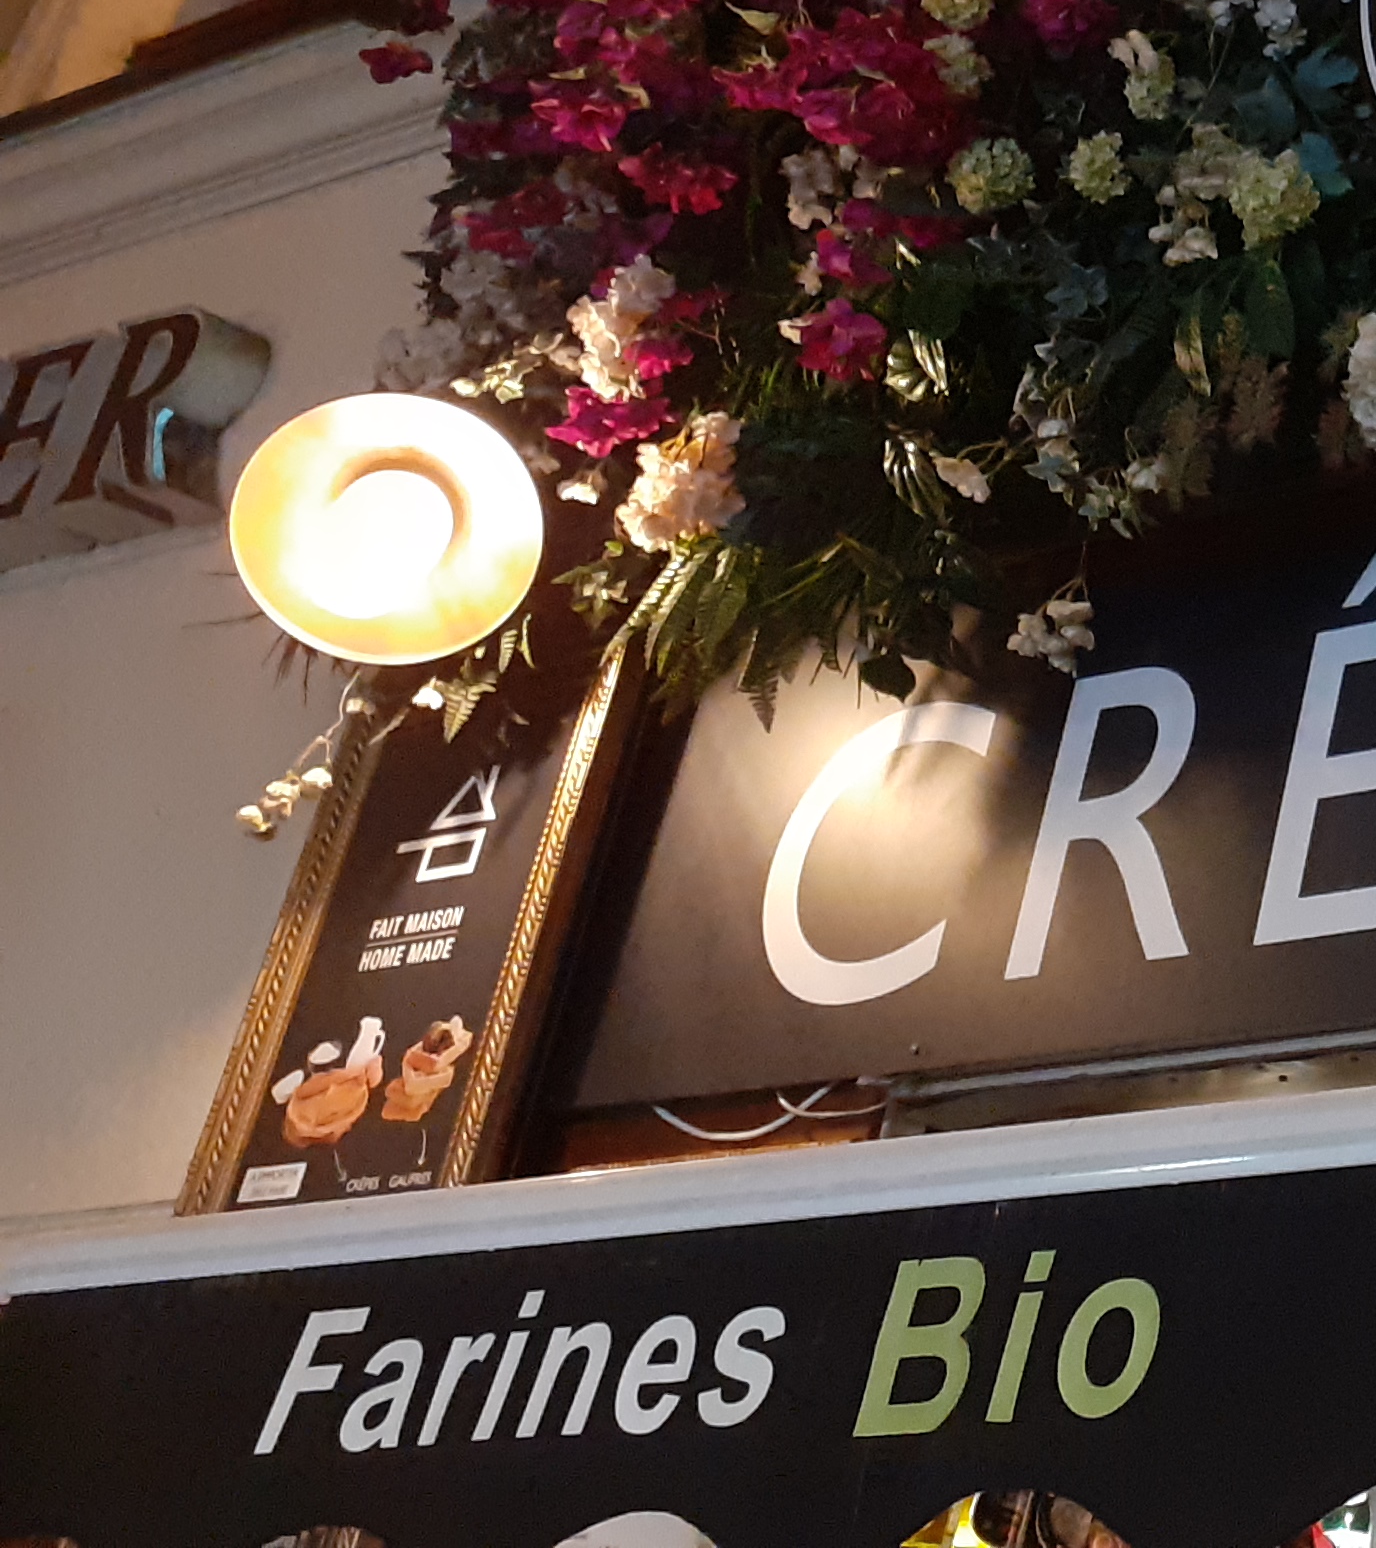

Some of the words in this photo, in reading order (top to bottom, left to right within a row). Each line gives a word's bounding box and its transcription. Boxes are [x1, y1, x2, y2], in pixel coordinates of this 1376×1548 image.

[369, 915, 405, 940] FAIT
[404, 905, 465, 935] MAISON
[358, 944, 407, 972] HOME
[406, 936, 456, 964] MADE
[254, 1289, 785, 1456] Farines
[852, 1249, 1162, 1439] Bio
